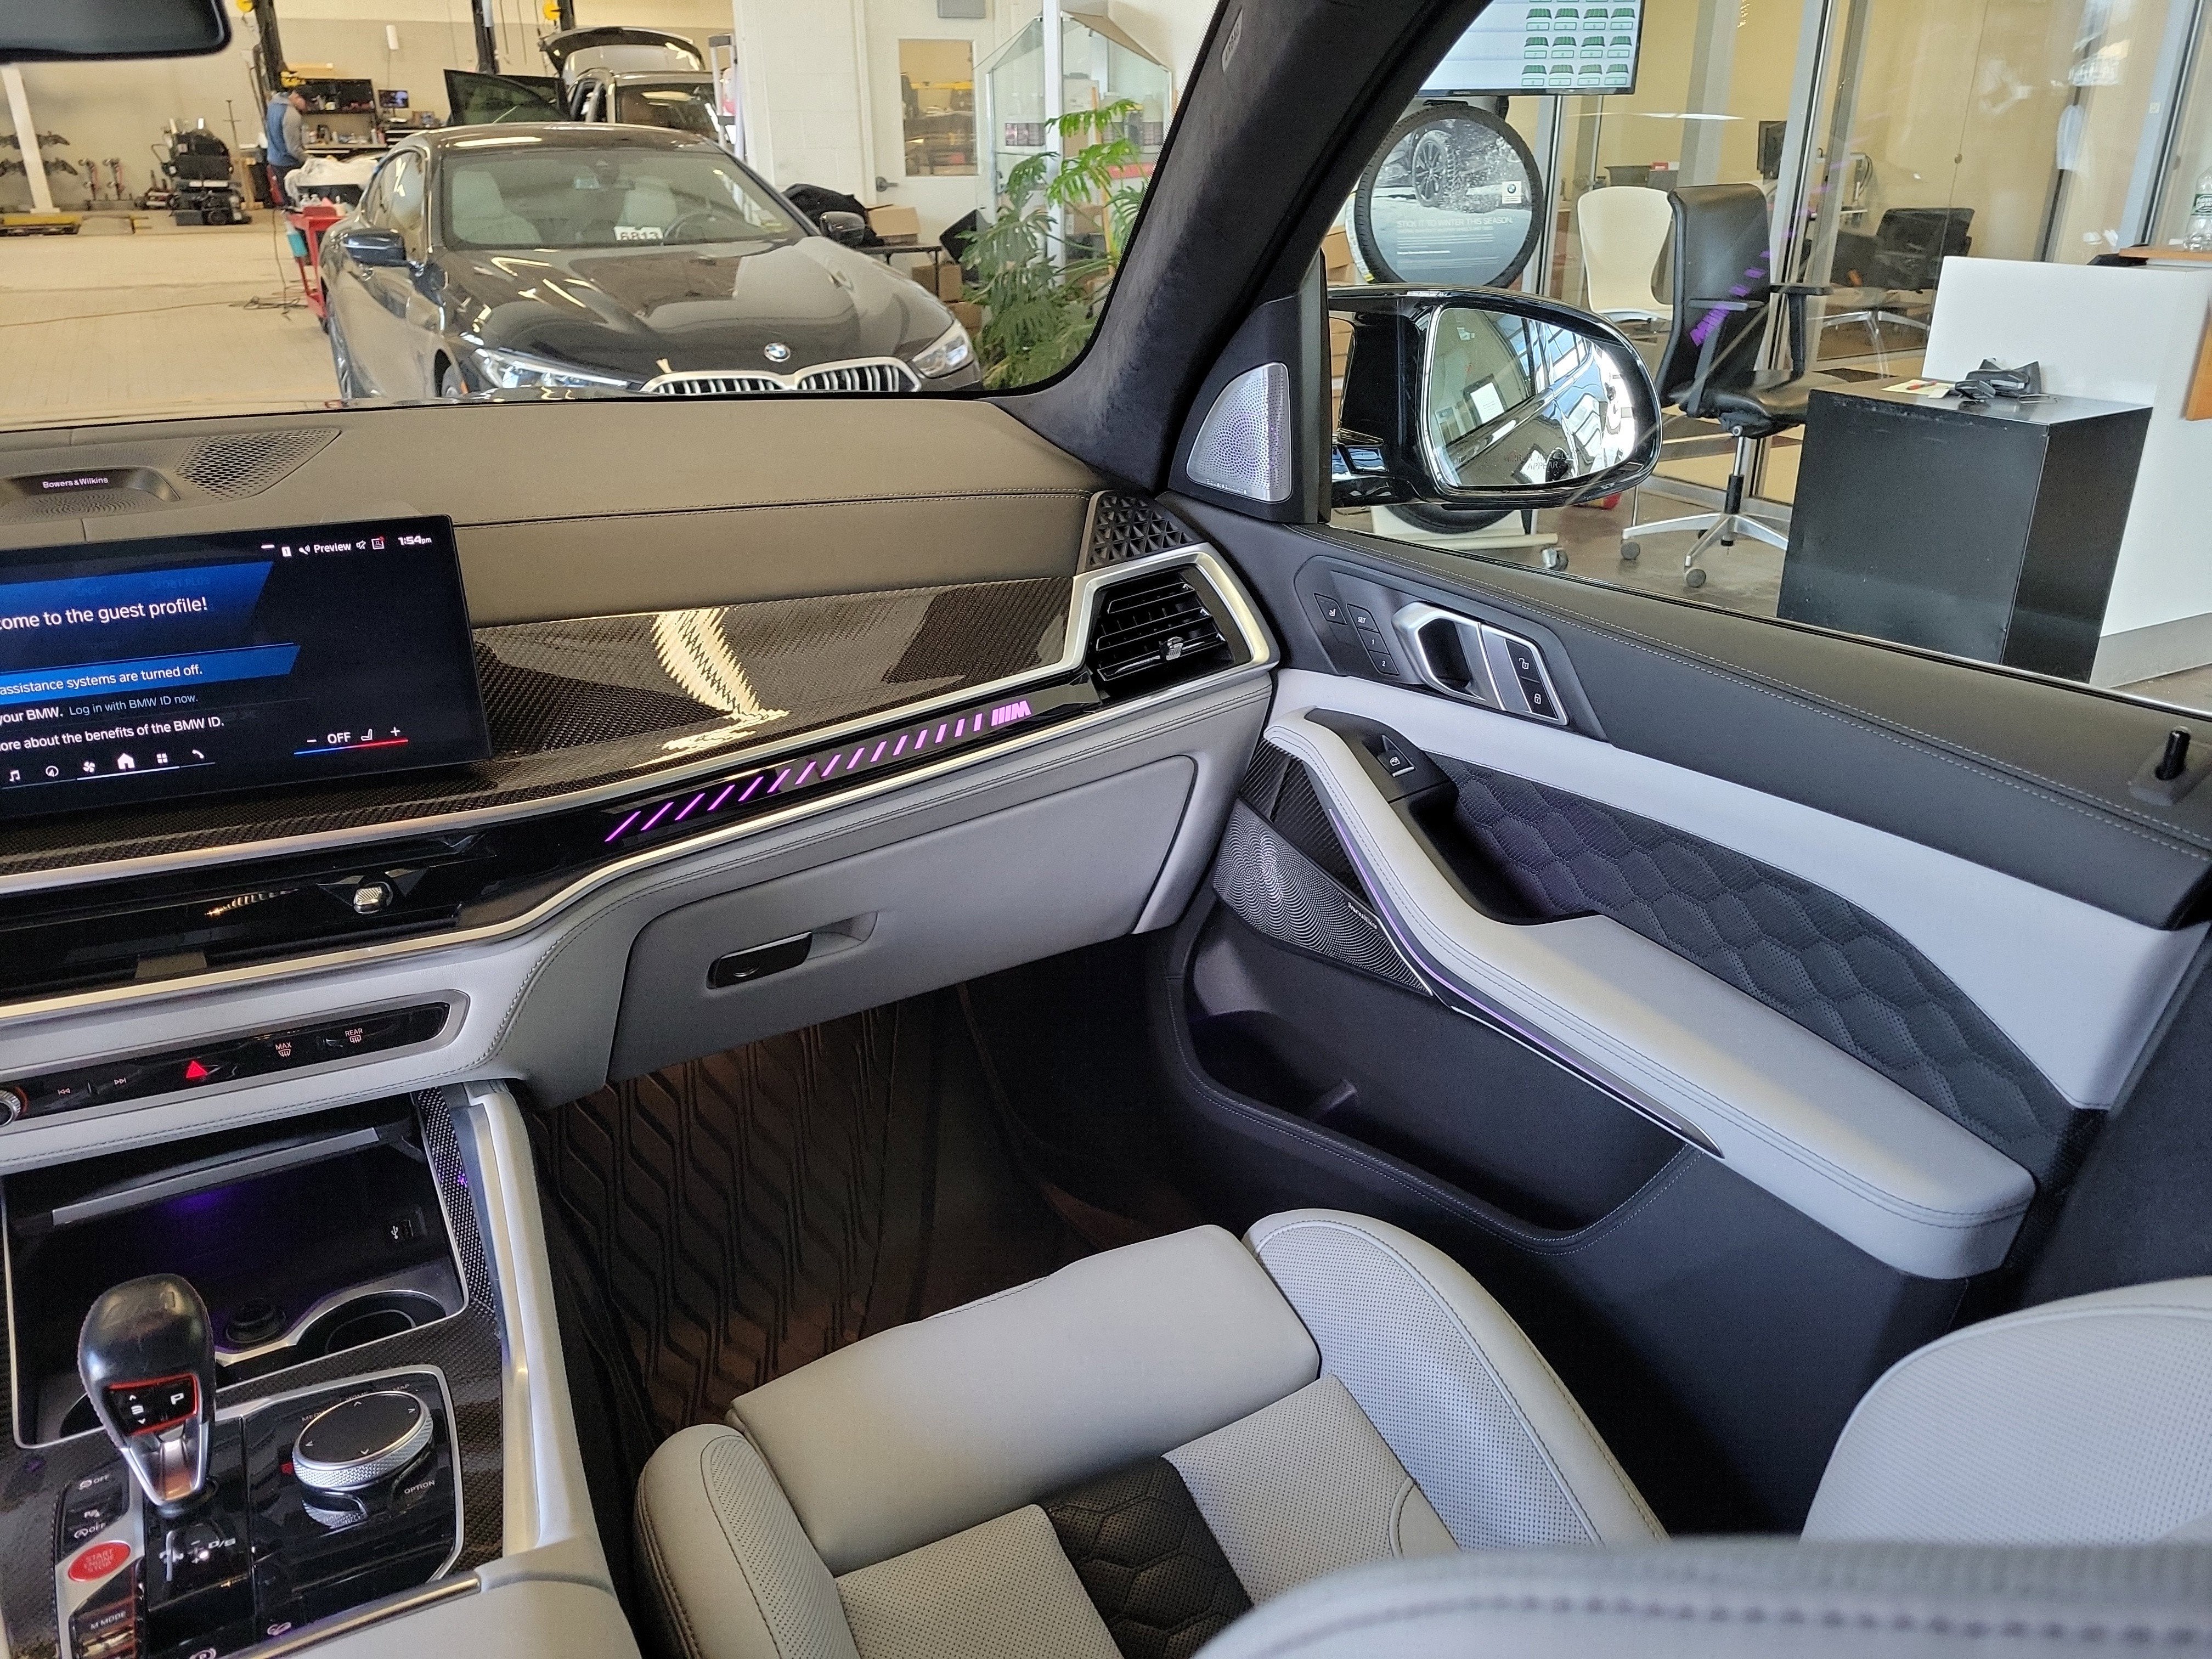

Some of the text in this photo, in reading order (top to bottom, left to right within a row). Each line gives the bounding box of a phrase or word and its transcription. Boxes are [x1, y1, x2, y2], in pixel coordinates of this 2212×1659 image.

[1527, 461, 1558, 470] APPEAR
[313, 542, 351, 554] Preview
[0, 596, 208, 630] ome to the guest profile!
[0, 664, 203, 696] assistance systems are turned off.
[26, 706, 63, 721] BMW.
[69, 705, 90, 716] Log
[93, 704, 103, 713] in
[104, 700, 127, 712] with
[129, 697, 157, 709] BMW
[160, 695, 171, 706] ID
[174, 695, 199, 704] now.
[0, 716, 225, 752] ore about the benefits of the BMW ID.
[327, 732, 351, 744] OFF
[345, 1028, 363, 1037] REAR
[275, 1042, 292, 1051] MAX
[170, 1392, 185, 1405] P
[404, 1480, 436, 1494] OPTION
[100, 1611, 126, 1626] MODE
